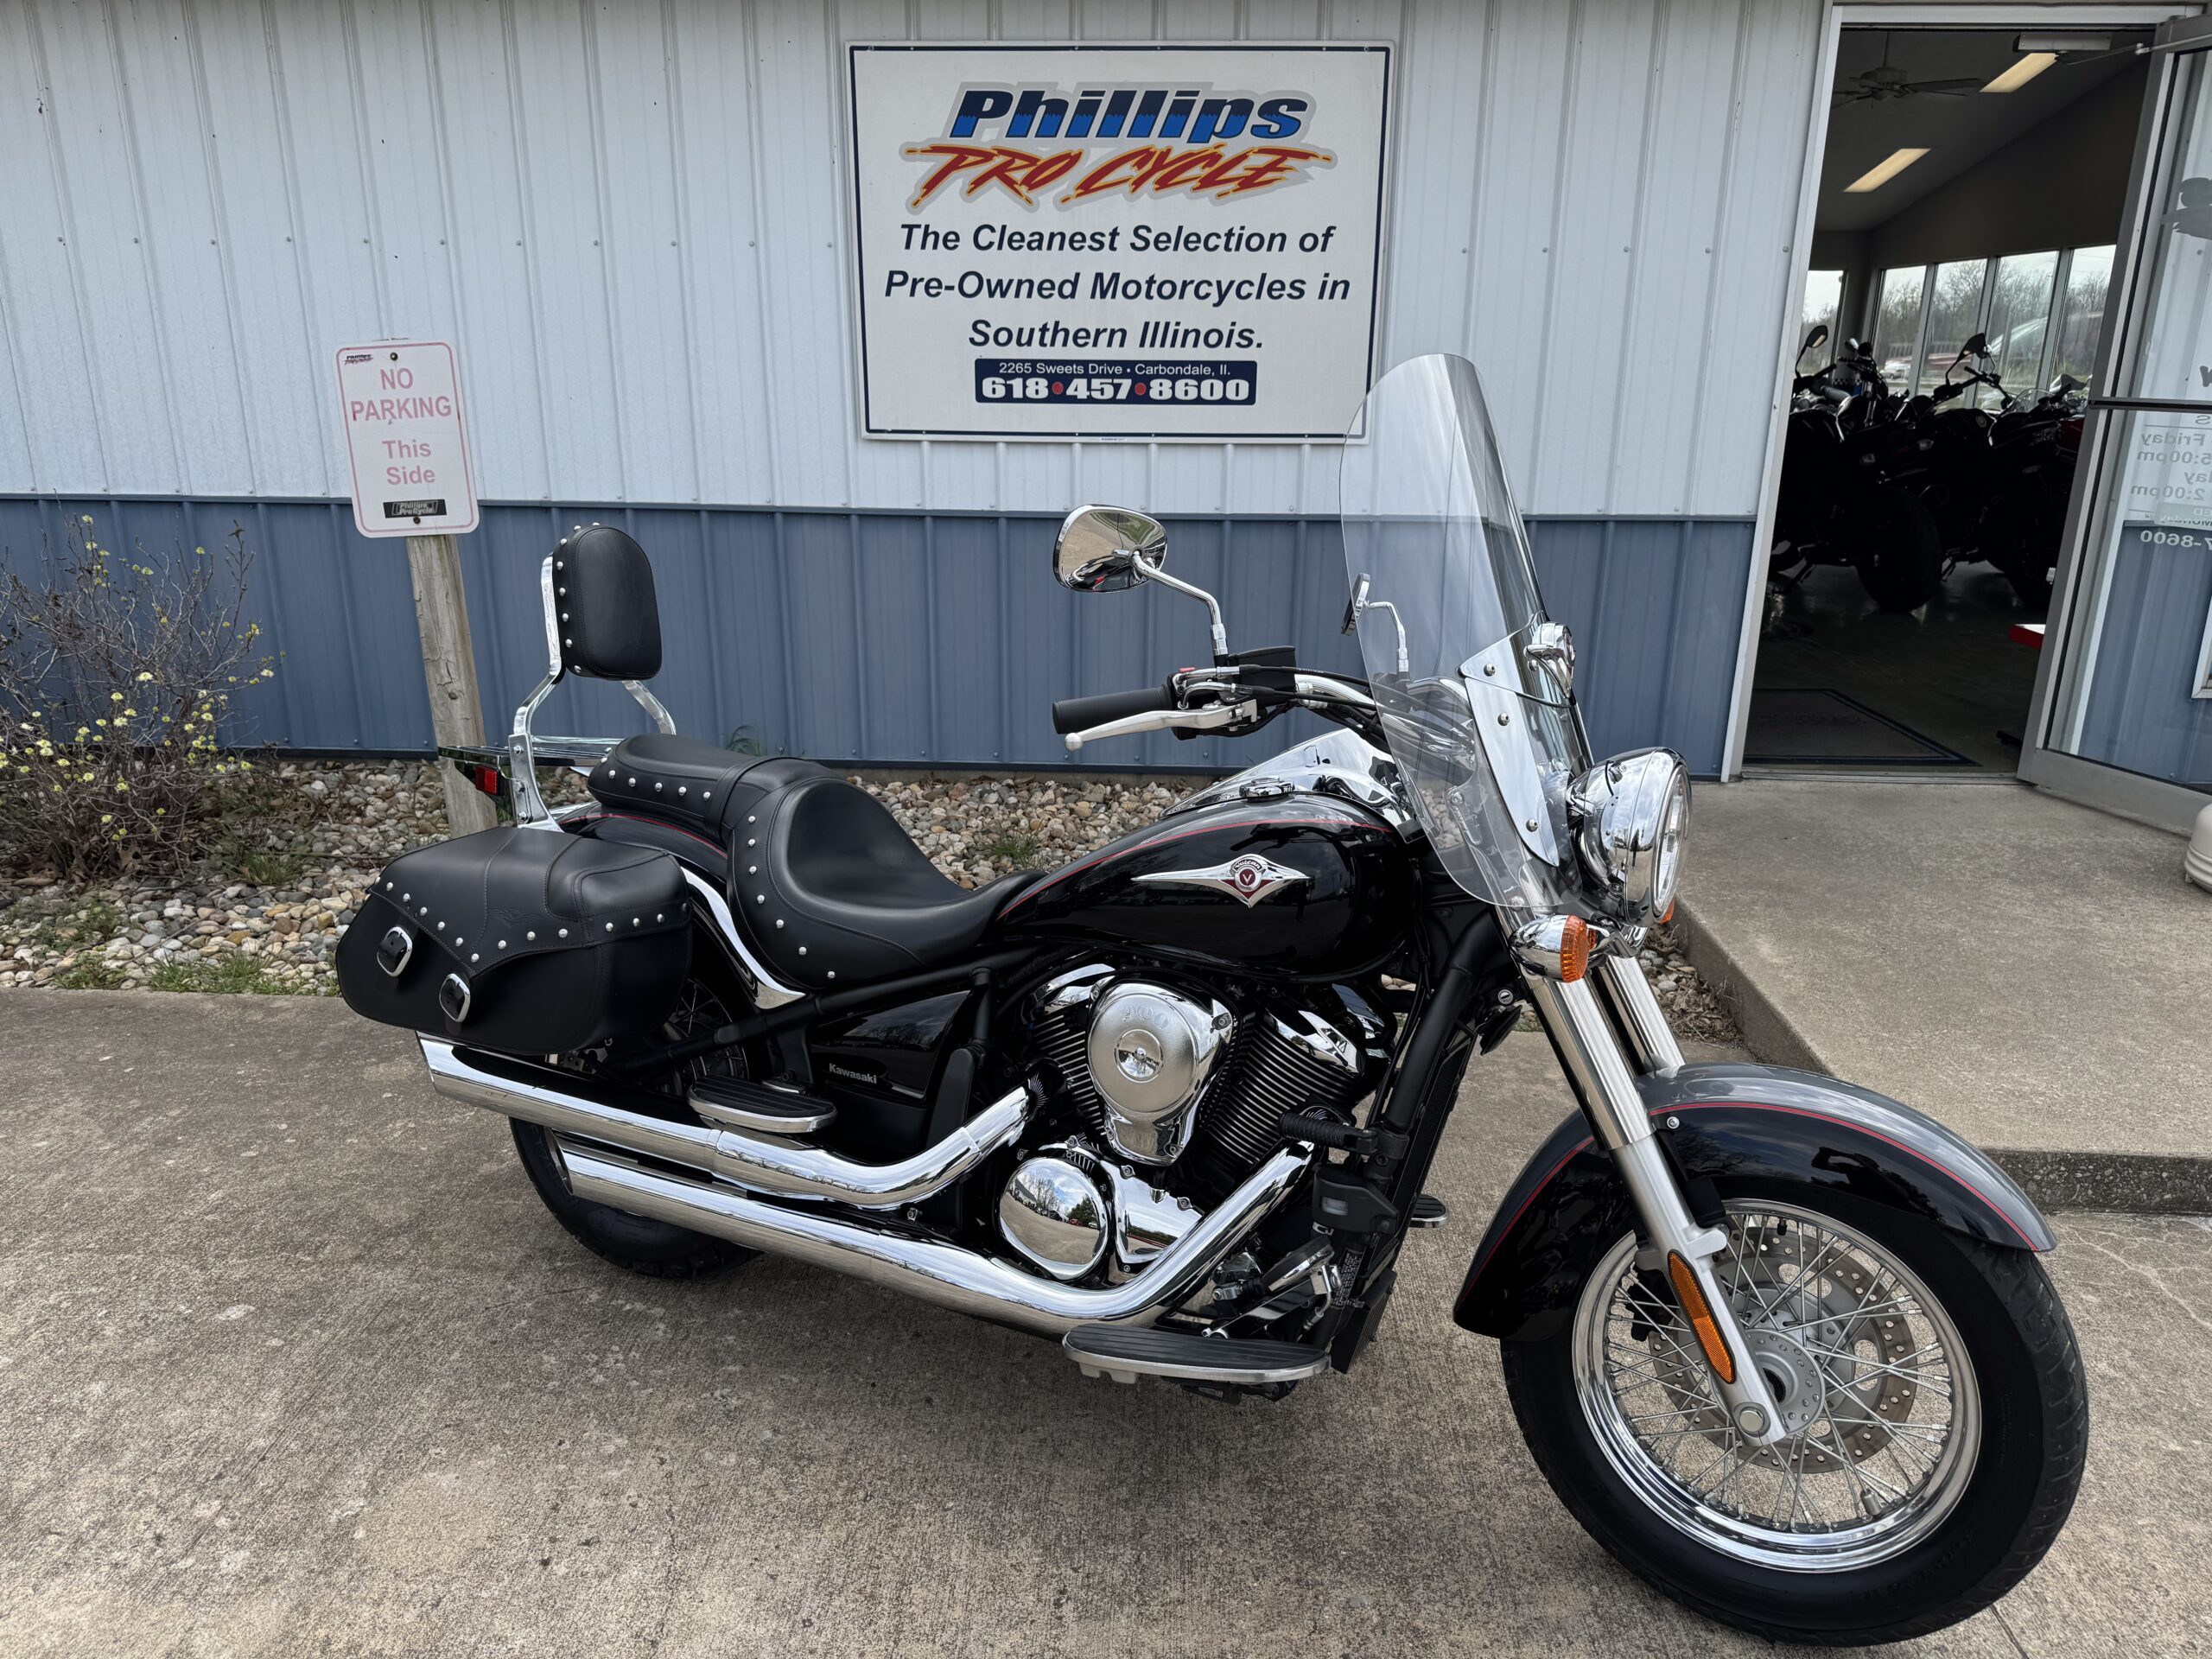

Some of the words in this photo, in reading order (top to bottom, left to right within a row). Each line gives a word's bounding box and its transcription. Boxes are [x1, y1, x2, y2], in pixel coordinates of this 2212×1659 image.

[949, 90, 1308, 144] Phillips
[905, 143, 1084, 207] PRO
[1060, 143, 1333, 205] CYCLE
[900, 224, 961, 251] The
[972, 224, 1120, 252] Cleanest
[1129, 225, 1287, 252] Selection
[1299, 226, 1337, 252] of
[885, 270, 1081, 300] Pre-Owned
[1090, 271, 1306, 308] Motorcycles
[1318, 272, 1351, 300] in
[969, 319, 1128, 348] Southern
[1139, 321, 1263, 349] Illinois.
[380, 367, 414, 390] NO
[999, 363, 1032, 374] 2265
[1036, 363, 1084, 374] Sweets
[1089, 363, 1122, 374] Drive
[1135, 364, 1214, 376] Carbondale,
[350, 395, 452, 422] PARKING
[381, 439, 432, 460] This
[386, 466, 435, 486] Side
[829, 1063, 877, 1084] Kawasaki
